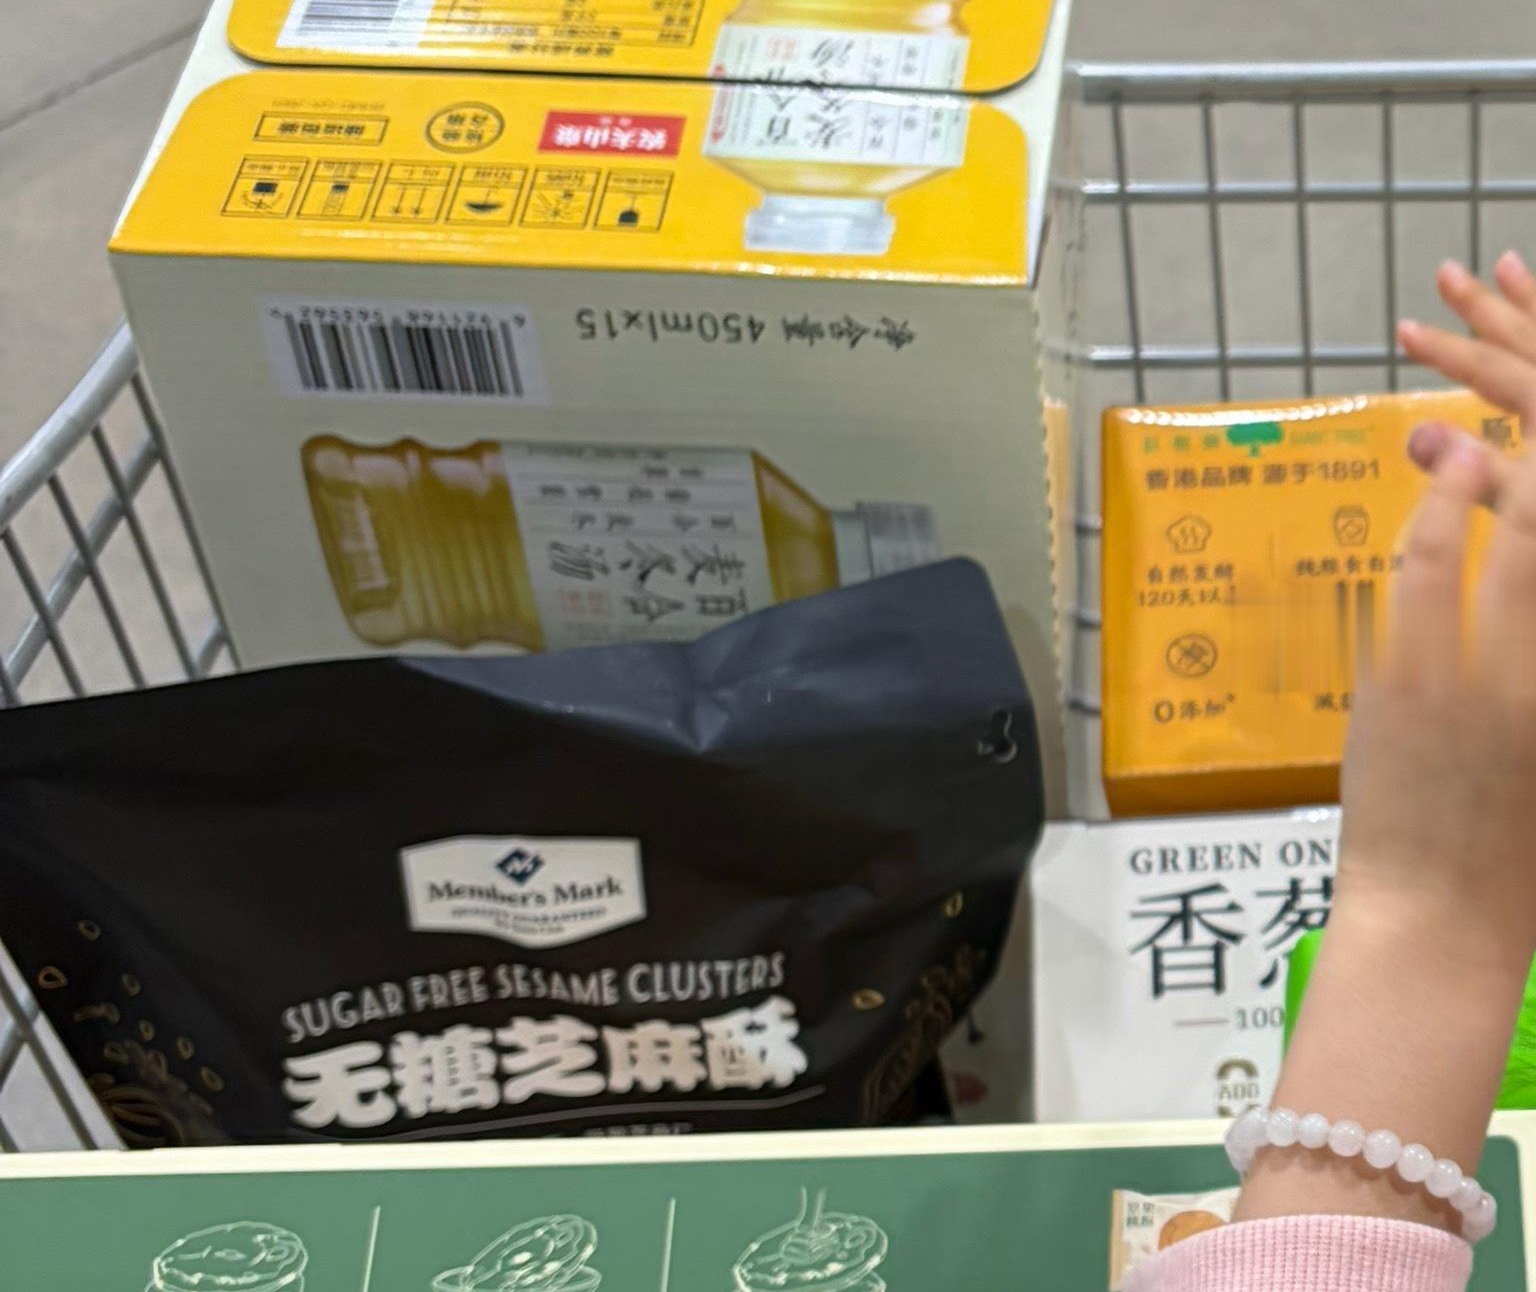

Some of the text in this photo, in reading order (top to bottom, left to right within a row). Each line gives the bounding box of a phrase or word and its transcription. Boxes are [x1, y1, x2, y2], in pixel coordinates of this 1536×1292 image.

[1145, 465, 1252, 491] 香港品牌
[1130, 843, 1263, 875] GREEN
[428, 876, 624, 906] Member's Mark
[284, 952, 787, 1043] SUGAR FREE SESAME CLUSTERS
[282, 997, 808, 1127] 无糖芝麻酥
